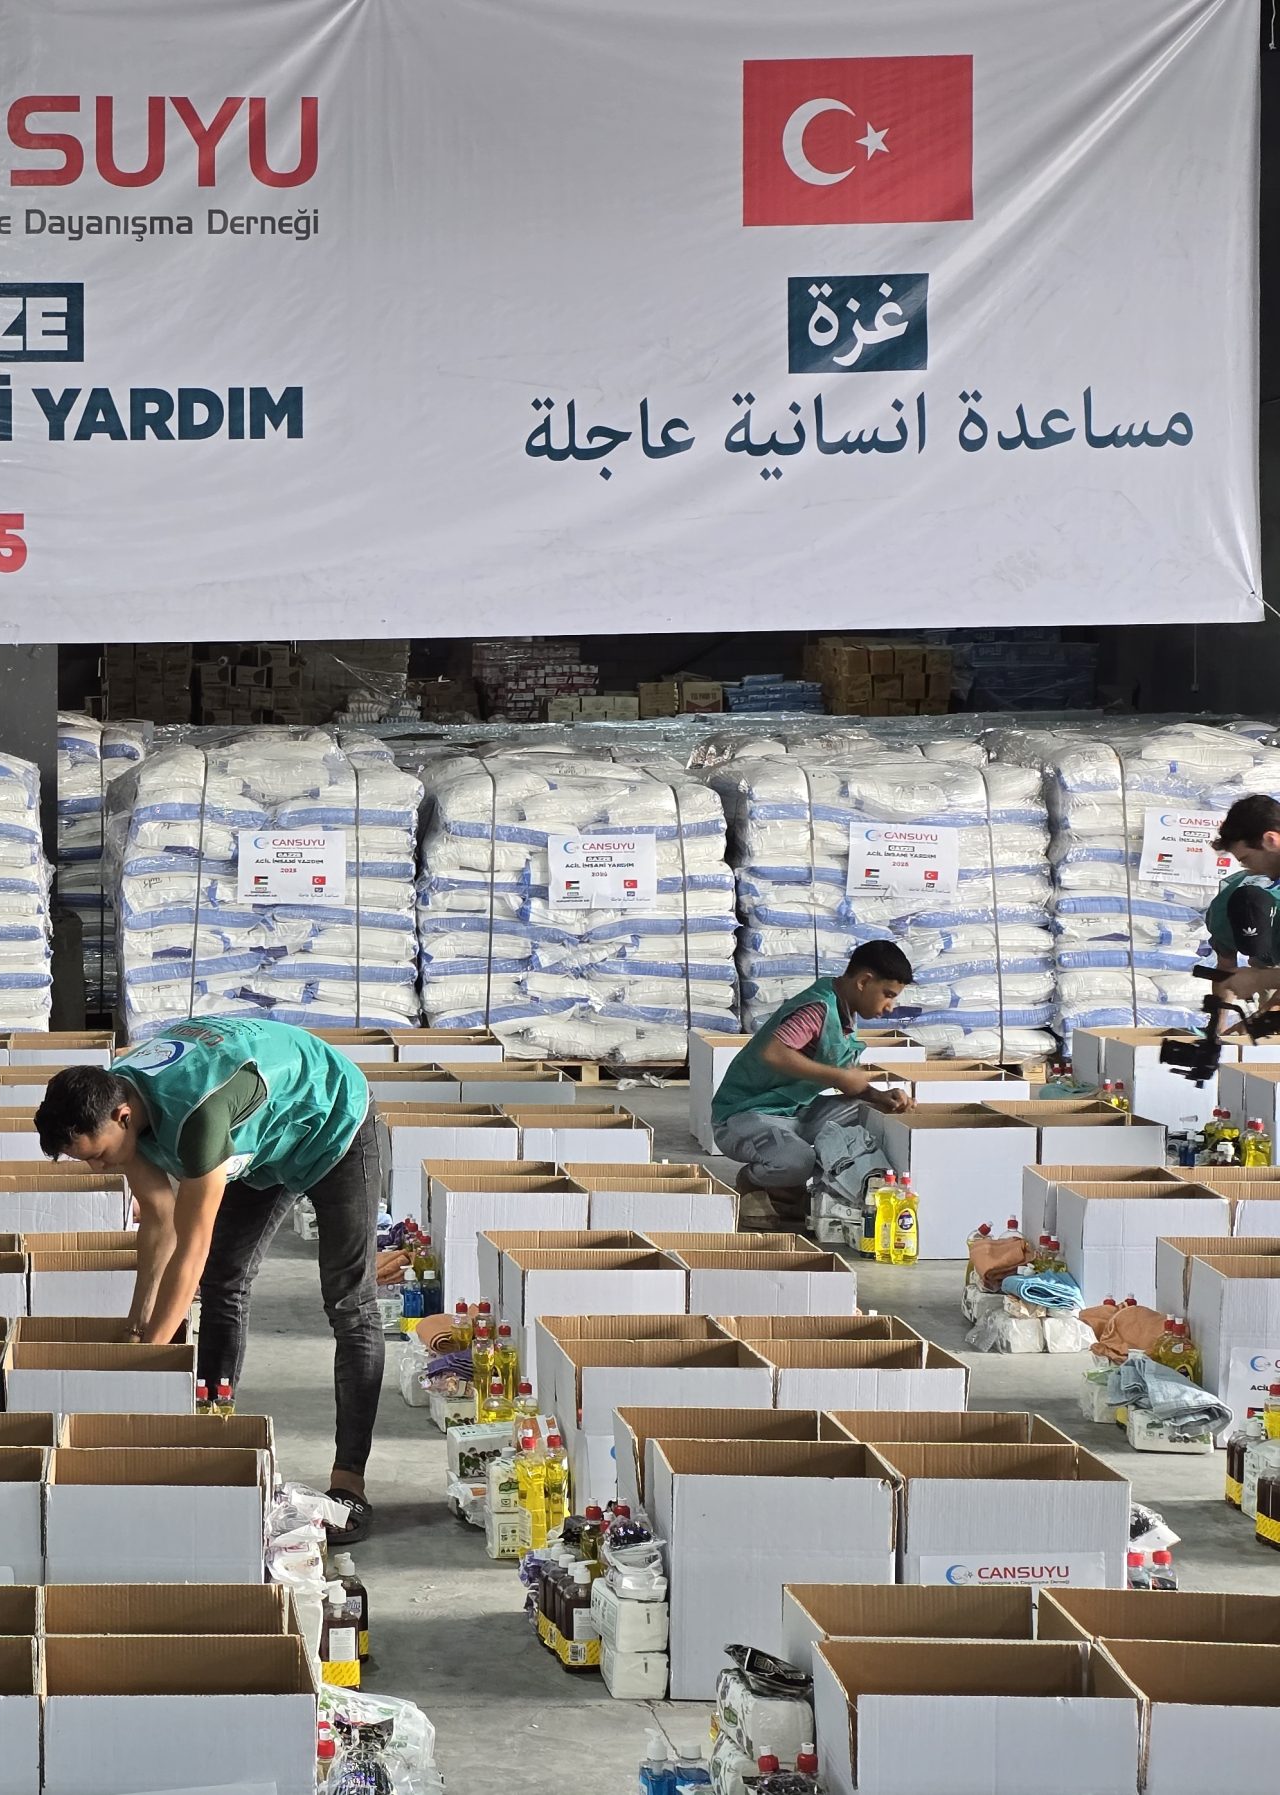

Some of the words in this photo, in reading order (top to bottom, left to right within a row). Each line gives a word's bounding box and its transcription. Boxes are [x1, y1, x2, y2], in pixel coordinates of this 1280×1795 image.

[25, 208, 193, 243] Dayanışma
[207, 207, 319, 241] Derneği
[808, 283, 909, 367] غزة
[31, 386, 304, 442] YARDIM
[959, 386, 1194, 453] مساعدة
[524, 396, 696, 481] عاجلة
[724, 391, 926, 481] انسانية
[884, 831, 938, 841] CANSUYU
[1179, 817, 1224, 827] CANSU
[272, 838, 325, 846] CANSUYU
[582, 842, 635, 850] CANSUYU
[978, 1566, 1070, 1579] CANSUYU
